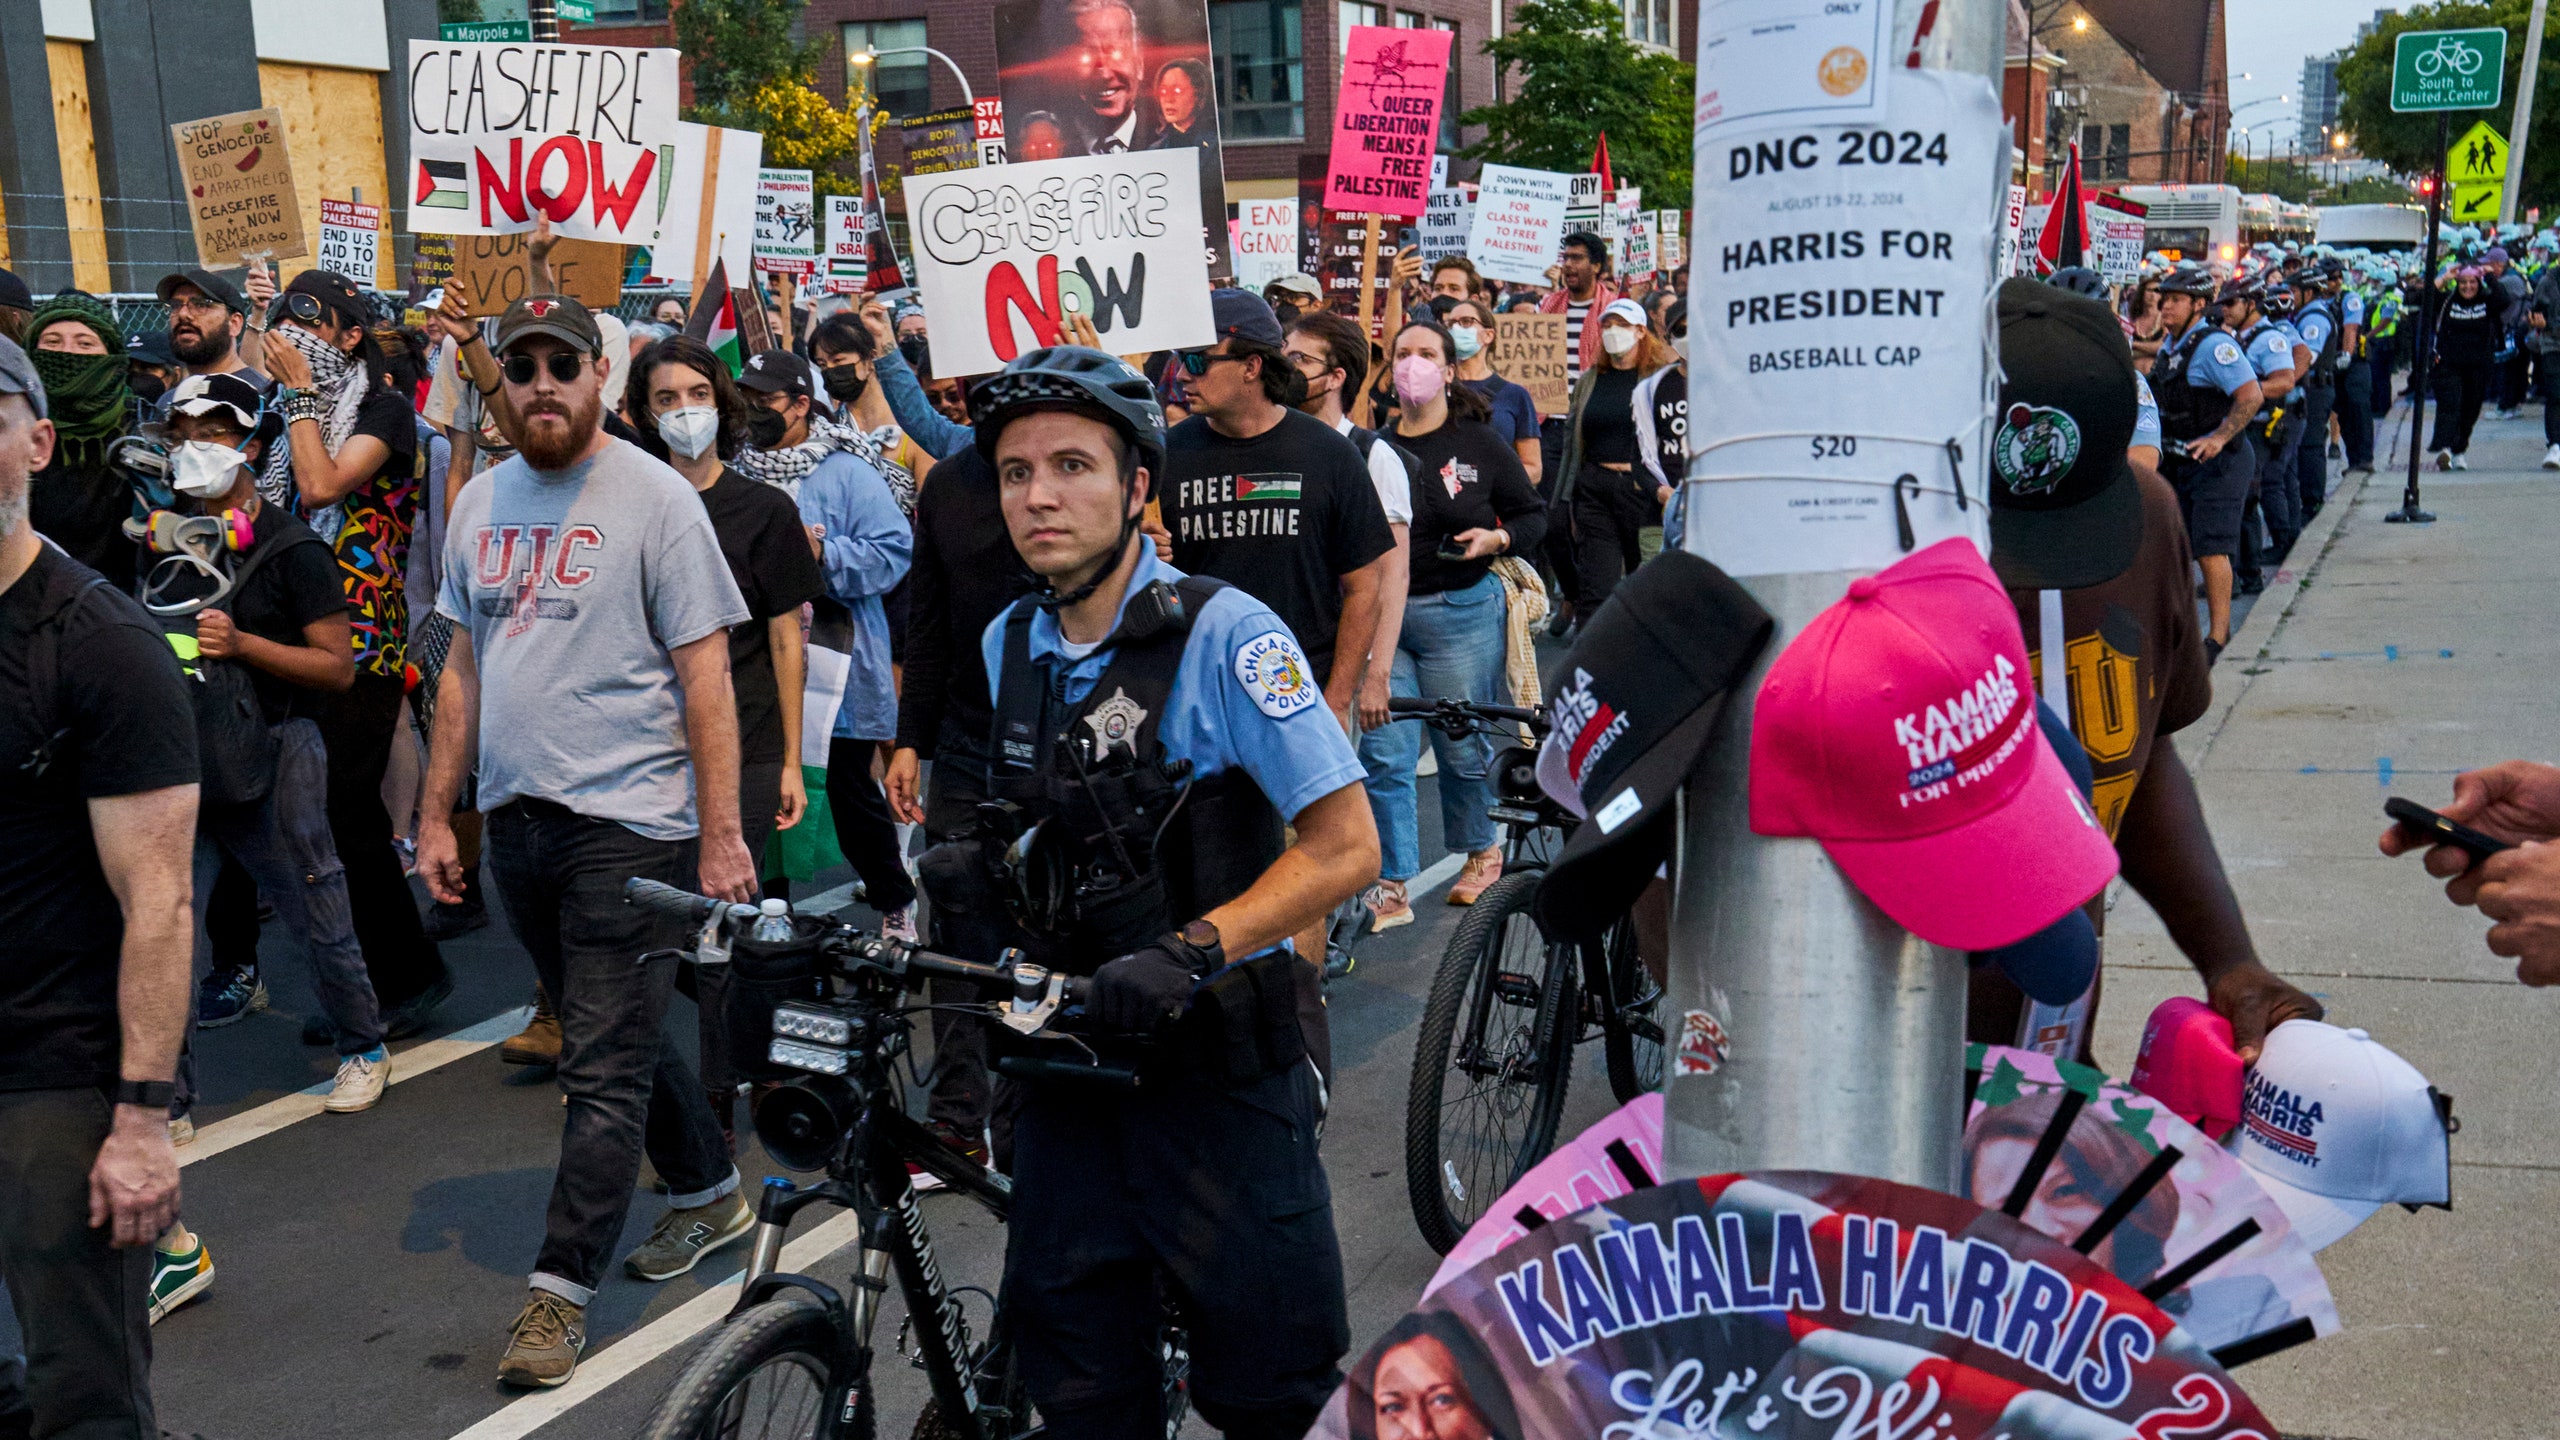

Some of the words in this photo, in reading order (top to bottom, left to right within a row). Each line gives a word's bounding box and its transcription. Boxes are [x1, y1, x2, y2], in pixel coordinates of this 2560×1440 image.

[1825, 2, 1862, 15] ONLY
[458, 25, 509, 42] Maypole
[513, 27, 523, 36] Av
[2419, 76, 2454, 90] South
[2461, 77, 2474, 88] to
[411, 47, 648, 145] CEASEFIRE
[2401, 91, 2441, 104] United
[2448, 89, 2490, 102] Center
[1382, 96, 1433, 116] QUEER
[903, 117, 924, 127] STAND
[926, 114, 943, 123] WITH
[1343, 113, 1430, 136] LIBERATION
[182, 120, 222, 144] STOP
[929, 128, 956, 141] BOTH
[196, 132, 273, 158] GENOCIDE
[911, 143, 968, 160] DEMOCRATS
[1362, 134, 1415, 155] MEANS
[1417, 139, 1427, 156] A
[1730, 134, 1819, 181] DNC
[1837, 130, 1949, 167] 2024
[192, 163, 222, 181] END
[914, 159, 978, 175] REPUBLICANS
[1381, 156, 1425, 178] FREE
[210, 172, 289, 197] APARTHEID
[771, 173, 809, 181] PALESTINE
[1334, 174, 1422, 199] PALESTINE
[1496, 175, 1526, 186] DOWN
[1529, 178, 1553, 189] WITH
[763, 182, 810, 192] PHILIPPINES
[1482, 185, 1500, 194] U.S.
[1503, 188, 1565, 202] IMPERIALISM!
[200, 194, 279, 220] CEASEFIRE
[322, 201, 352, 214] STAND
[354, 205, 379, 217] WITH
[836, 201, 858, 212] END
[1454, 193, 1462, 208] &
[1509, 201, 1530, 212] FOR
[1767, 196, 1821, 214] AUGUST
[1871, 193, 1903, 206] 2024
[246, 209, 281, 228] NOW
[323, 211, 378, 229] PALESTINE!
[756, 212, 773, 222] THE
[920, 172, 1168, 265] CEASEFIRE
[1251, 205, 1292, 226] END
[1336, 212, 1356, 221] FREE
[1427, 213, 1456, 227] FIGHT
[1486, 212, 1520, 224] CLASS
[1523, 217, 1549, 228] WAR
[1639, 214, 1654, 222] THE
[205, 226, 249, 246] ARMS
[216, 232, 288, 253] EMBARGO
[324, 228, 348, 242] END
[353, 232, 373, 246] U.S
[756, 228, 774, 239] U.S.
[849, 231, 862, 242] TO
[1423, 236, 1438, 246] FOR
[1496, 226, 1510, 236] TO
[1513, 229, 1537, 240] FREE
[321, 243, 347, 258] AID
[353, 247, 373, 262] TO
[755, 244, 773, 254] WAR
[774, 245, 813, 256] MACHINE!
[836, 243, 867, 255] ISRA
[1334, 245, 1361, 256] U.S.
[1484, 238, 1544, 254] PALESTINE!
[1722, 230, 1865, 273] HARRIS
[1881, 230, 1953, 260] FOR
[2107, 241, 2123, 249] END
[2106, 251, 2122, 260] AID
[2127, 252, 2139, 260] TO
[321, 259, 373, 278] ISRAEL!
[2104, 261, 2138, 271] ISRAEL!
[472, 262, 582, 306] VOE
[985, 252, 1145, 363] NOW
[1728, 288, 1945, 328] PRESIDENT
[1749, 347, 1868, 374] BASEBALL
[1875, 346, 1921, 367] CAP
[1521, 364, 1565, 378] END
[1811, 435, 1857, 460] $20
[1180, 475, 1233, 508] FREE
[1180, 508, 1300, 543] PALESTINE
[473, 522, 605, 590] UIC
[1245, 638, 1300, 684] CHICAGO
[1894, 653, 2015, 746] KAMALA
[1907, 679, 2019, 768] HARRIS
[1909, 760, 1955, 788] 2024
[1899, 781, 1949, 808] FOR
[2247, 1068, 2324, 1123] KAMALA
[2244, 1088, 2314, 1137] HARRIS
[2245, 1127, 2321, 1168] PRESIDENT
[1495, 1211, 1825, 1368] KAMALA
[1841, 1213, 2156, 1408] HARRIS
[1601, 1358, 1780, 1440] Let's
